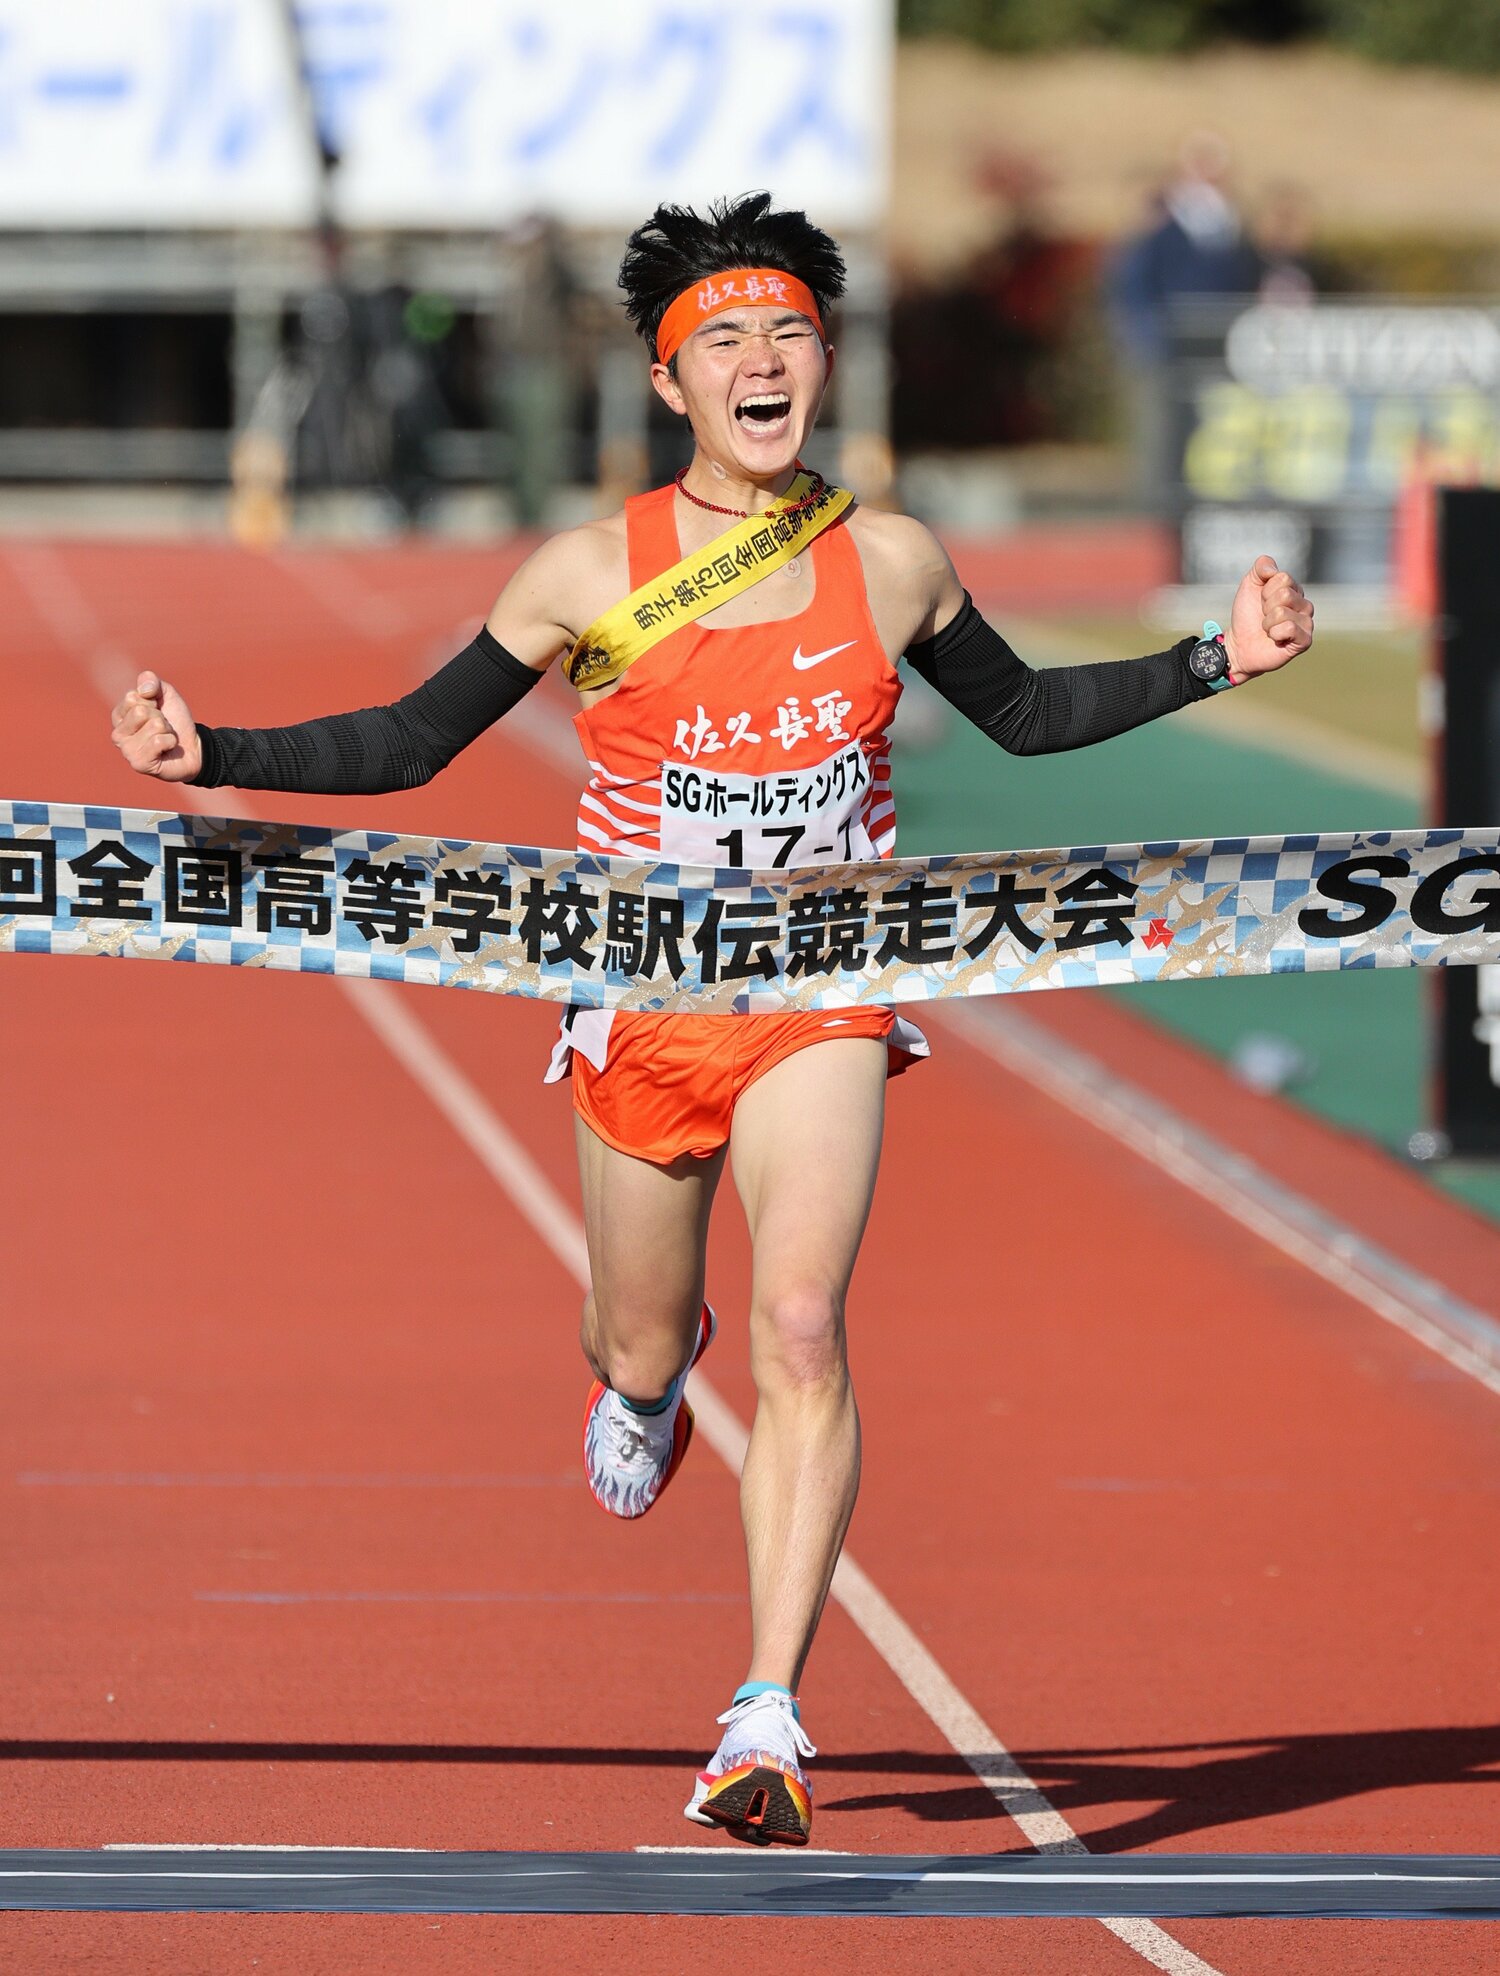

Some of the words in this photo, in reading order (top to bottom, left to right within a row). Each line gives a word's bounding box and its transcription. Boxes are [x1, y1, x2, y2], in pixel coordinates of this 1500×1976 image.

[697, 275, 791, 311] 佐久長聖
[673, 689, 852, 760] 佐久長聖
[666, 750, 867, 818] SGホールディングス
[0, 837, 1140, 985] 回全国高等学校駅伝競走大会
[1298, 854, 1500, 938] SG
